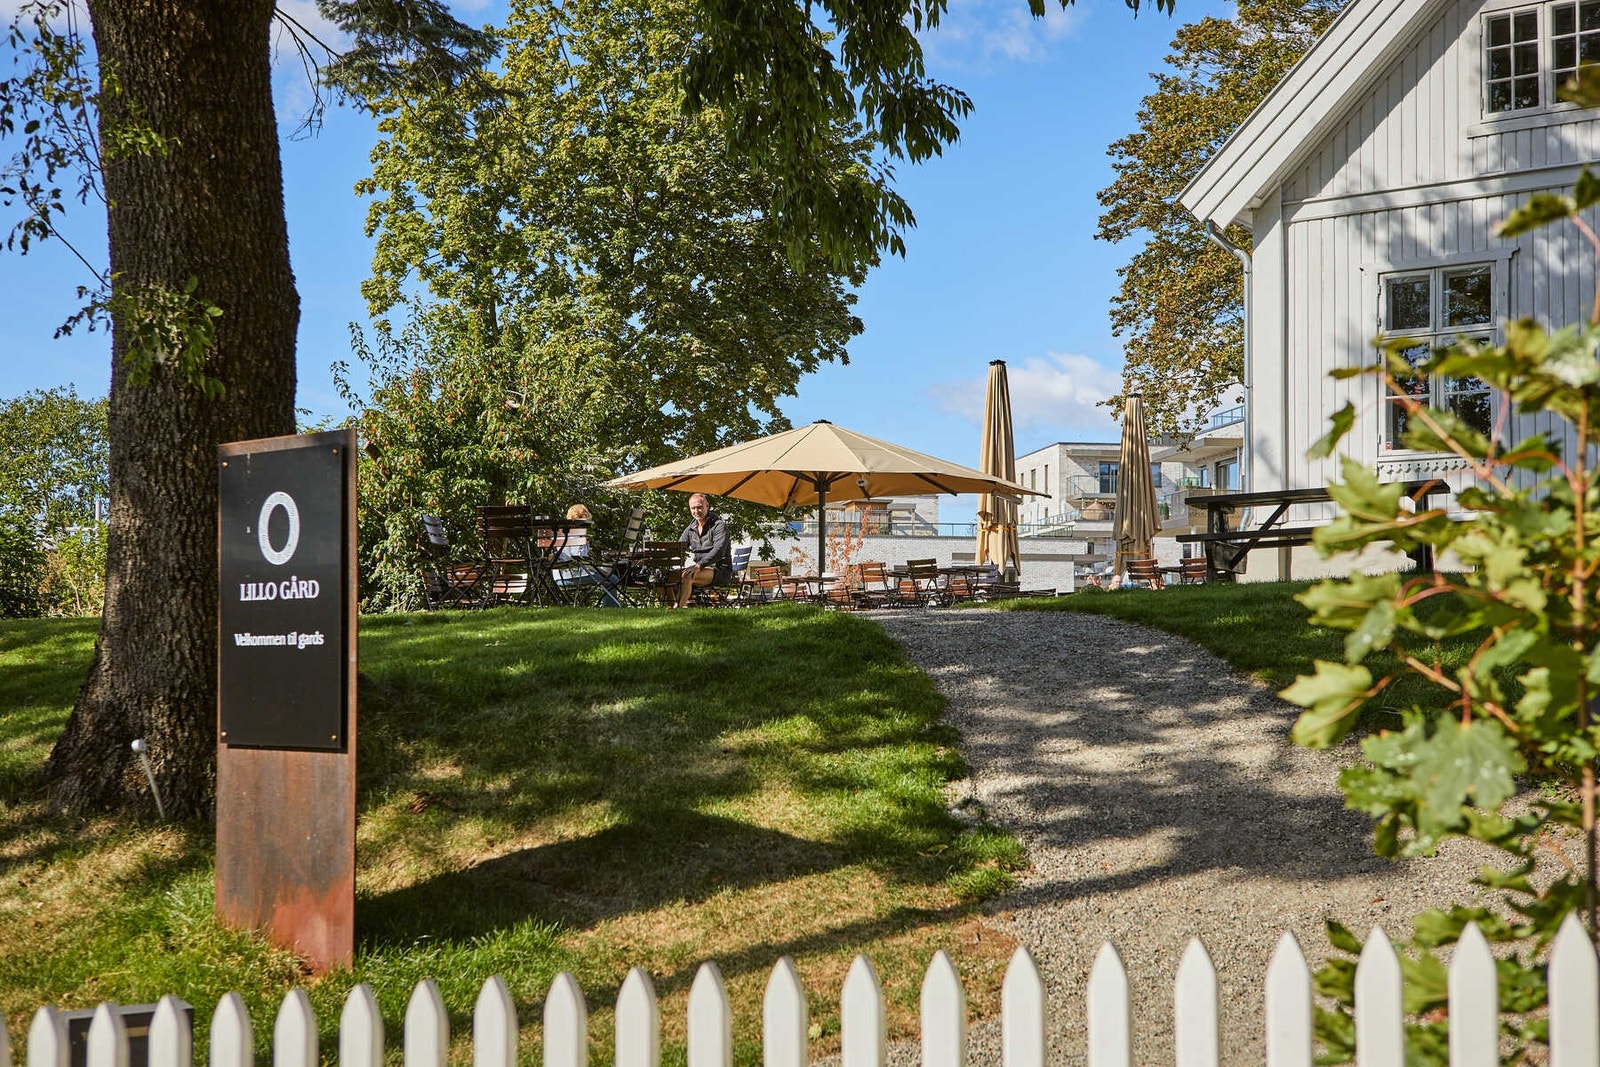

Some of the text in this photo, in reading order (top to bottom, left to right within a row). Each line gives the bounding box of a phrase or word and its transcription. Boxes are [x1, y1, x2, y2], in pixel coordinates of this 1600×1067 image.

[239, 575, 320, 602] LILLO GÅRD
[233, 632, 286, 647] Velkommen
[286, 631, 298, 646] til
